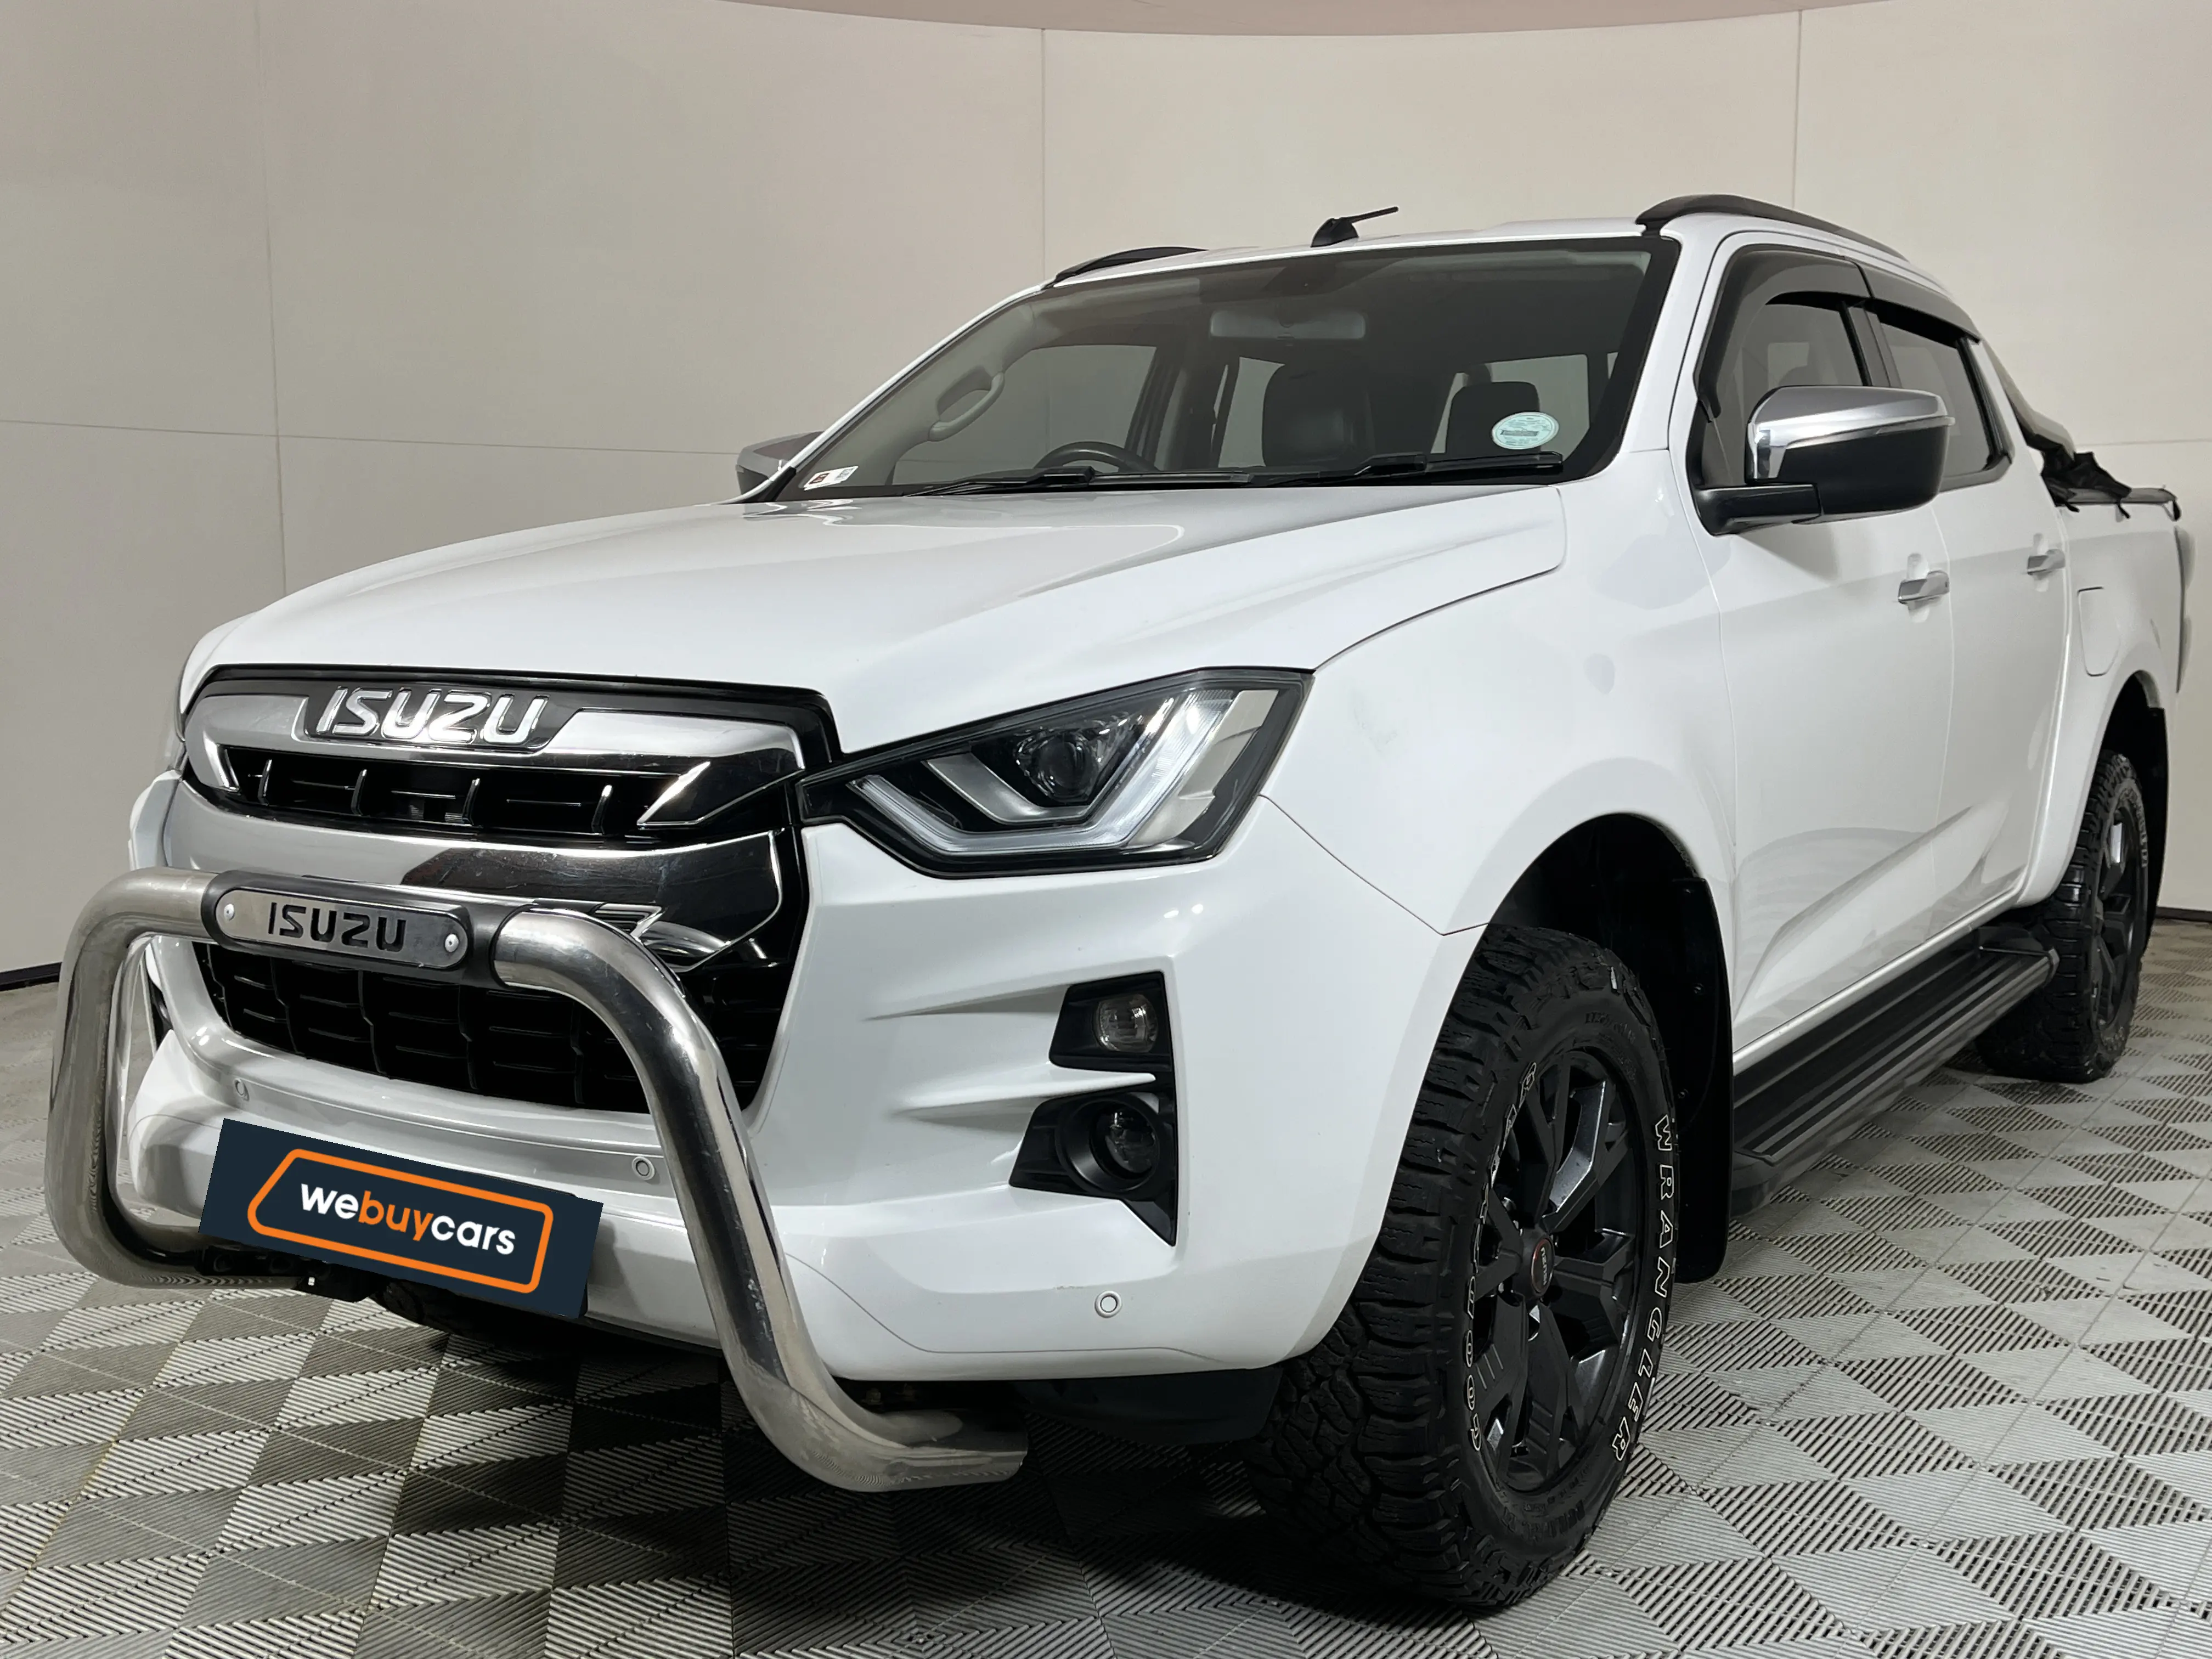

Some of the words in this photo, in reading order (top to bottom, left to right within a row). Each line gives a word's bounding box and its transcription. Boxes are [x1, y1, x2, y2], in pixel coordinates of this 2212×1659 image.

[315, 686, 549, 744] ISUZU
[268, 901, 407, 953] ISUZU
[1611, 1114, 1675, 1462] WRANGLER
